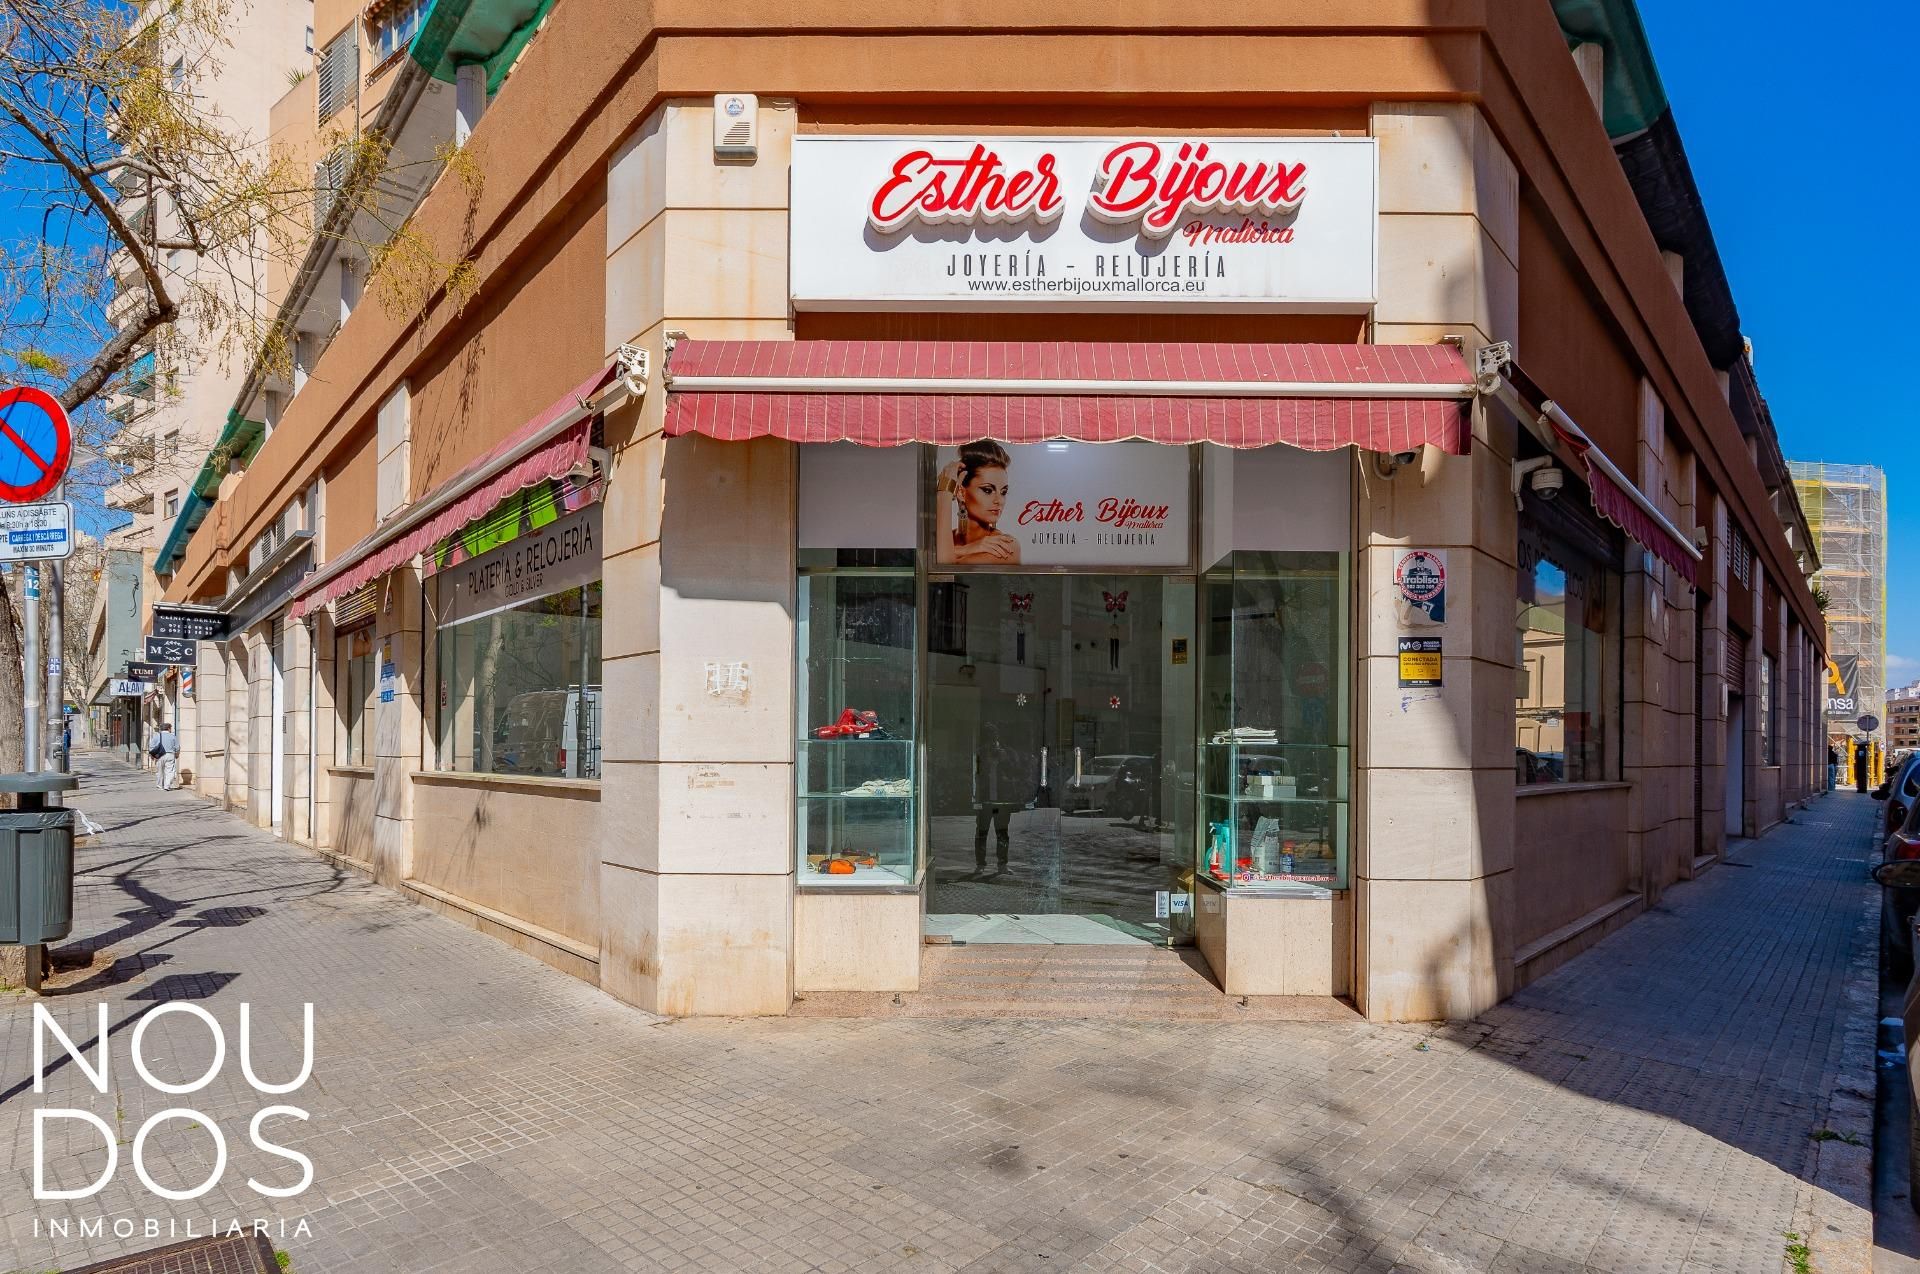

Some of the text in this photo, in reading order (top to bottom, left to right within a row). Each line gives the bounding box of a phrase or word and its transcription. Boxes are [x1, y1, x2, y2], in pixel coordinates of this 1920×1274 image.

[872, 142, 1305, 227] Esther Bijoux
[946, 250, 1046, 277] JOYERÍA
[1095, 250, 1226, 278] RELOJERÍA
[967, 277, 1206, 295] www.estherbijouxmallorca.eu
[1017, 497, 1169, 528] Esther Bijoux
[1031, 530, 1077, 545] JOYERÍA
[1096, 531, 1155, 546] RELOJERÍA
[468, 516, 593, 597] PLATERÍA & RELOJERÍA
[1402, 575, 1439, 584] Trablisa
[150, 646, 162, 654] M
[184, 648, 193, 656] C
[1828, 697, 1854, 710] nsa
